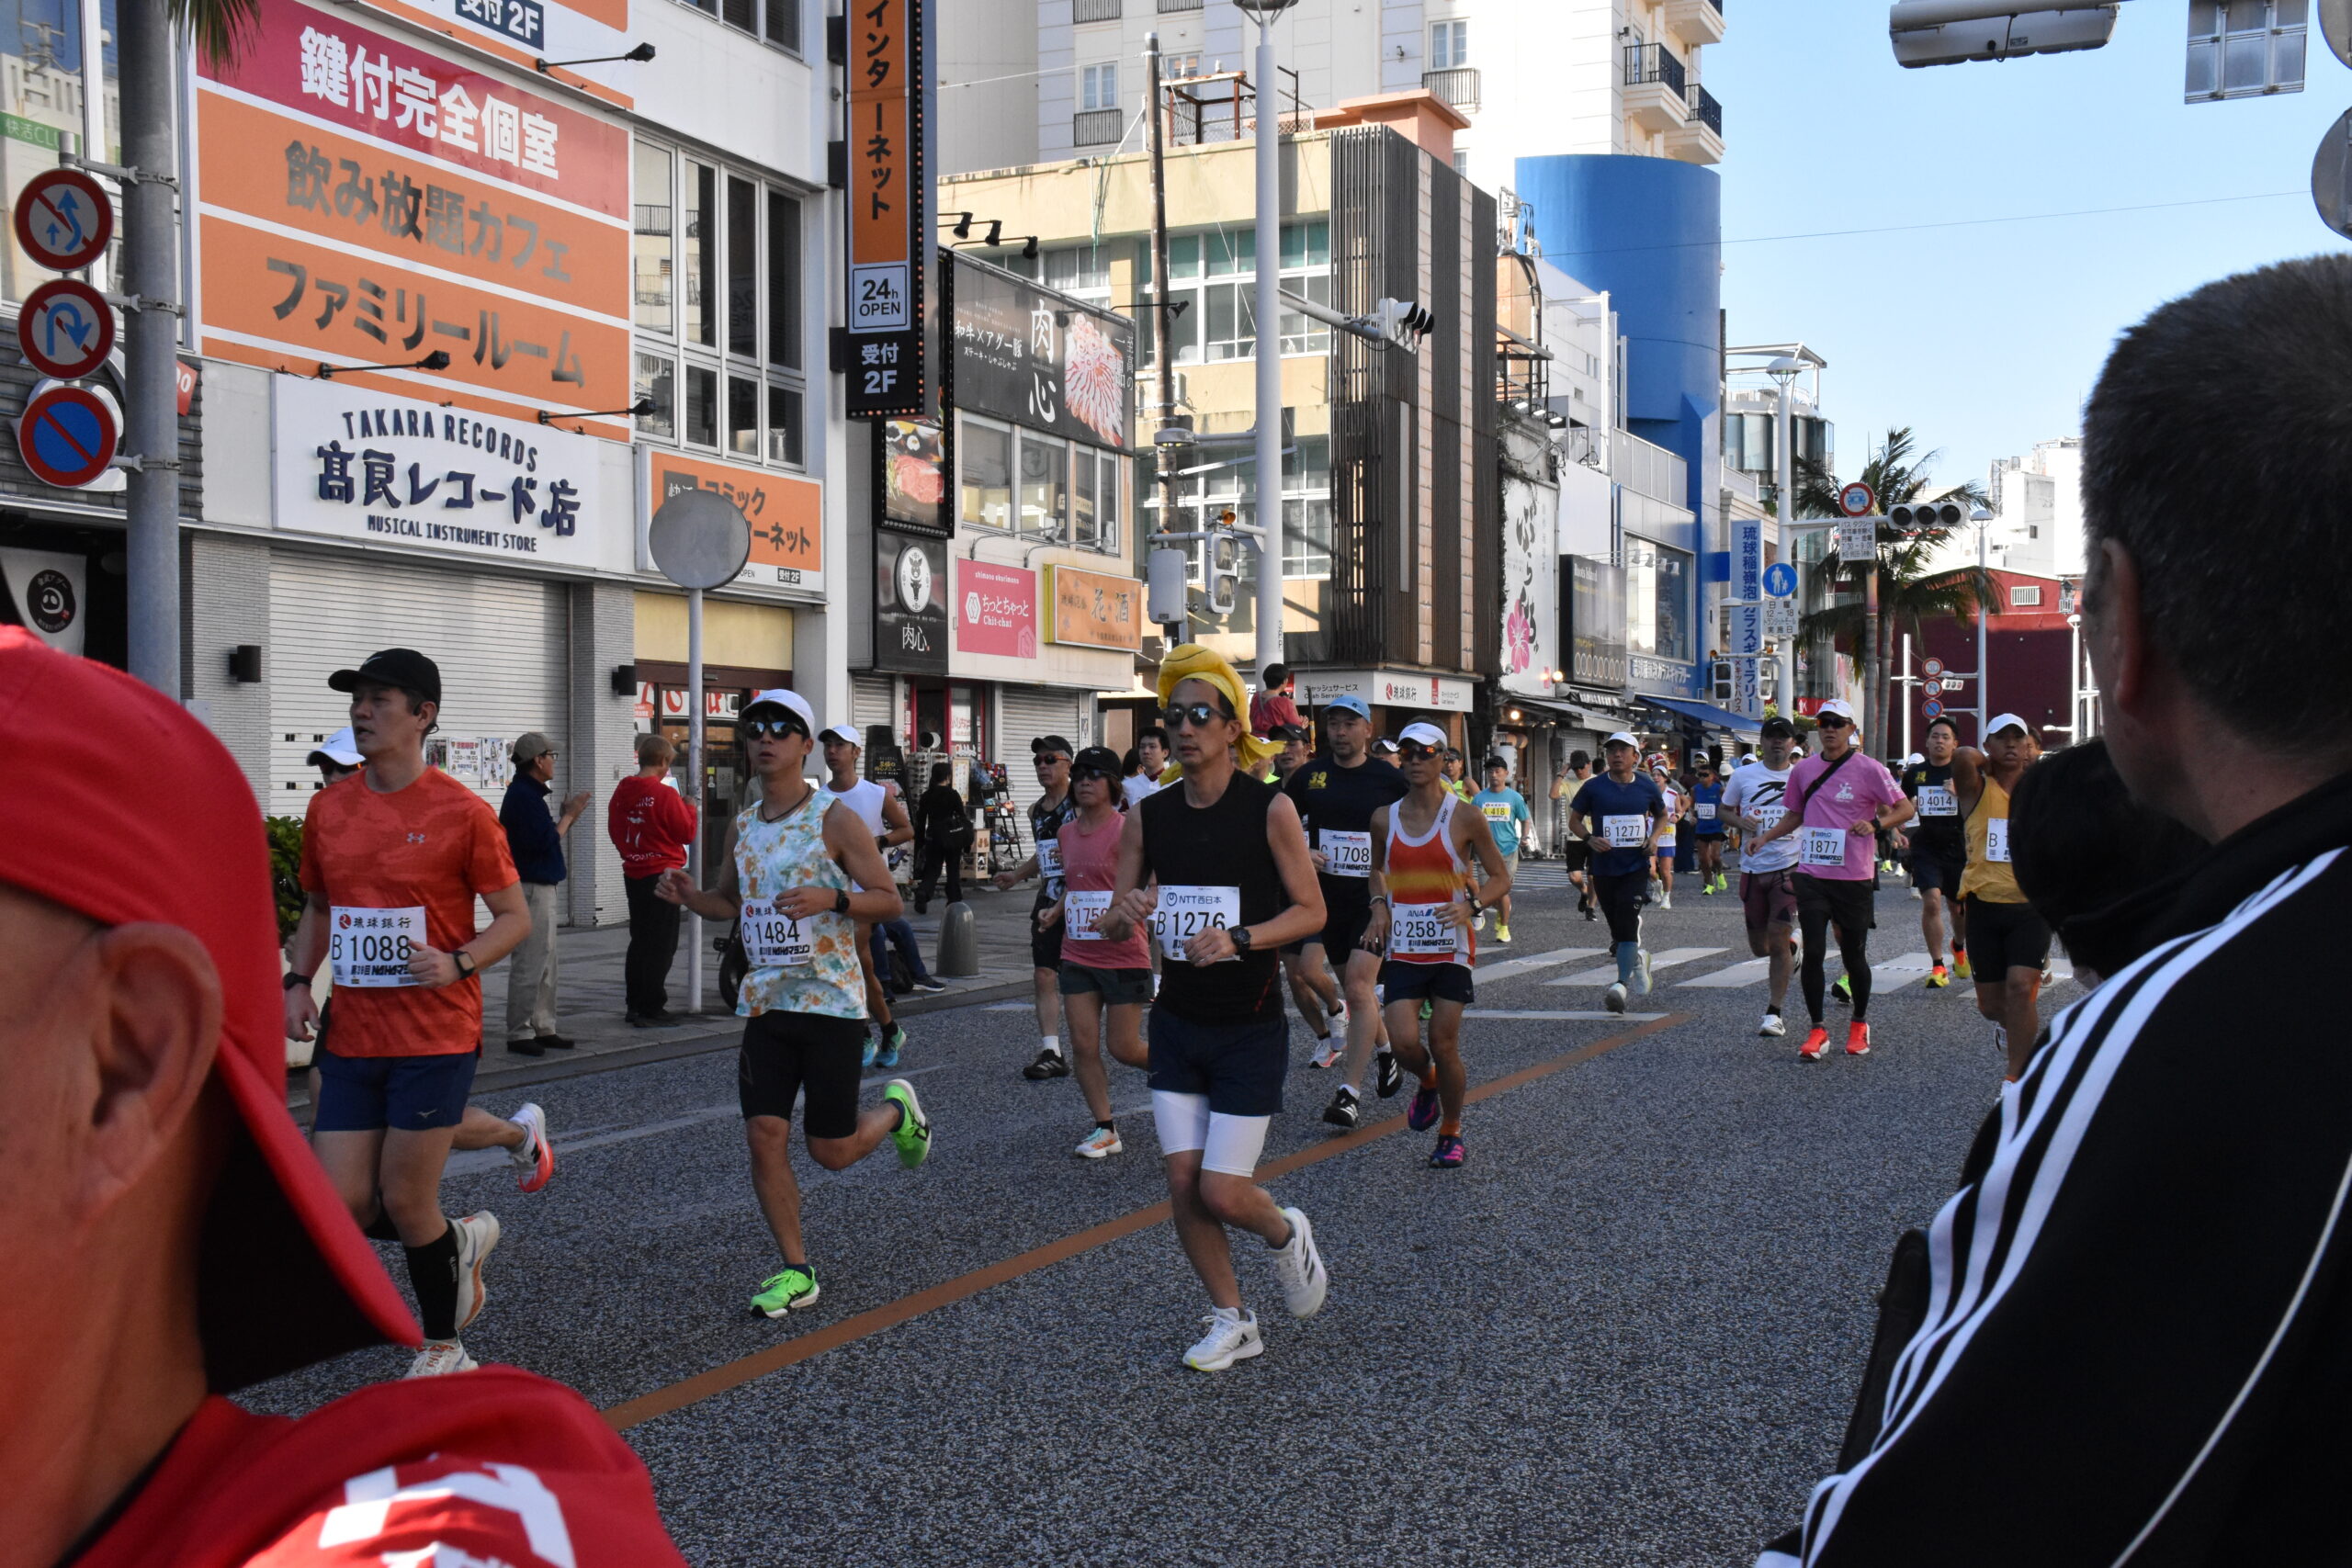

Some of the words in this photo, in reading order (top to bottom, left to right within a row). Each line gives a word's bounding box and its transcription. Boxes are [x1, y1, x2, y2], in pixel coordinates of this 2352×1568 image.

[508, 1, 539, 39] 2F
[300, 26, 560, 180] 鍵付完全個室
[865, 0, 892, 220] インターネット
[285, 140, 571, 284] 飲み放題カフェ
[862, 278, 899, 301] 24h
[859, 301, 901, 316] OPEN
[266, 256, 584, 389] ファミリールーム
[862, 343, 899, 365] 受付
[865, 370, 898, 394] 2F
[343, 408, 435, 440] TAKARA
[445, 413, 538, 472] RECORDS
[368, 514, 423, 537] MUSICAL
[426, 522, 500, 548] INSTRUMENT
[503, 536, 537, 552] STORE
[982, 593, 1029, 617] ちっとちゃっと
[983, 615, 1012, 628] Chit-chat
[1490, 807, 1506, 816] 418
[1927, 796, 1953, 807] 4014
[1604, 827, 1611, 838] B
[1616, 825, 1641, 837] 1277
[1760, 817, 1781, 829] 127
[1809, 840, 1838, 854] 1877
[1988, 833, 1998, 847] B
[1333, 846, 1370, 863] 1708
[1179, 895, 1222, 905] NTT西日本
[353, 917, 412, 929] 琉球銀行
[742, 921, 752, 944] C
[754, 919, 800, 944] 1484
[1156, 911, 1167, 935] B
[1172, 911, 1226, 936] 1276
[1393, 919, 1402, 937] C
[332, 933, 343, 961] B
[350, 934, 412, 962] 1088
